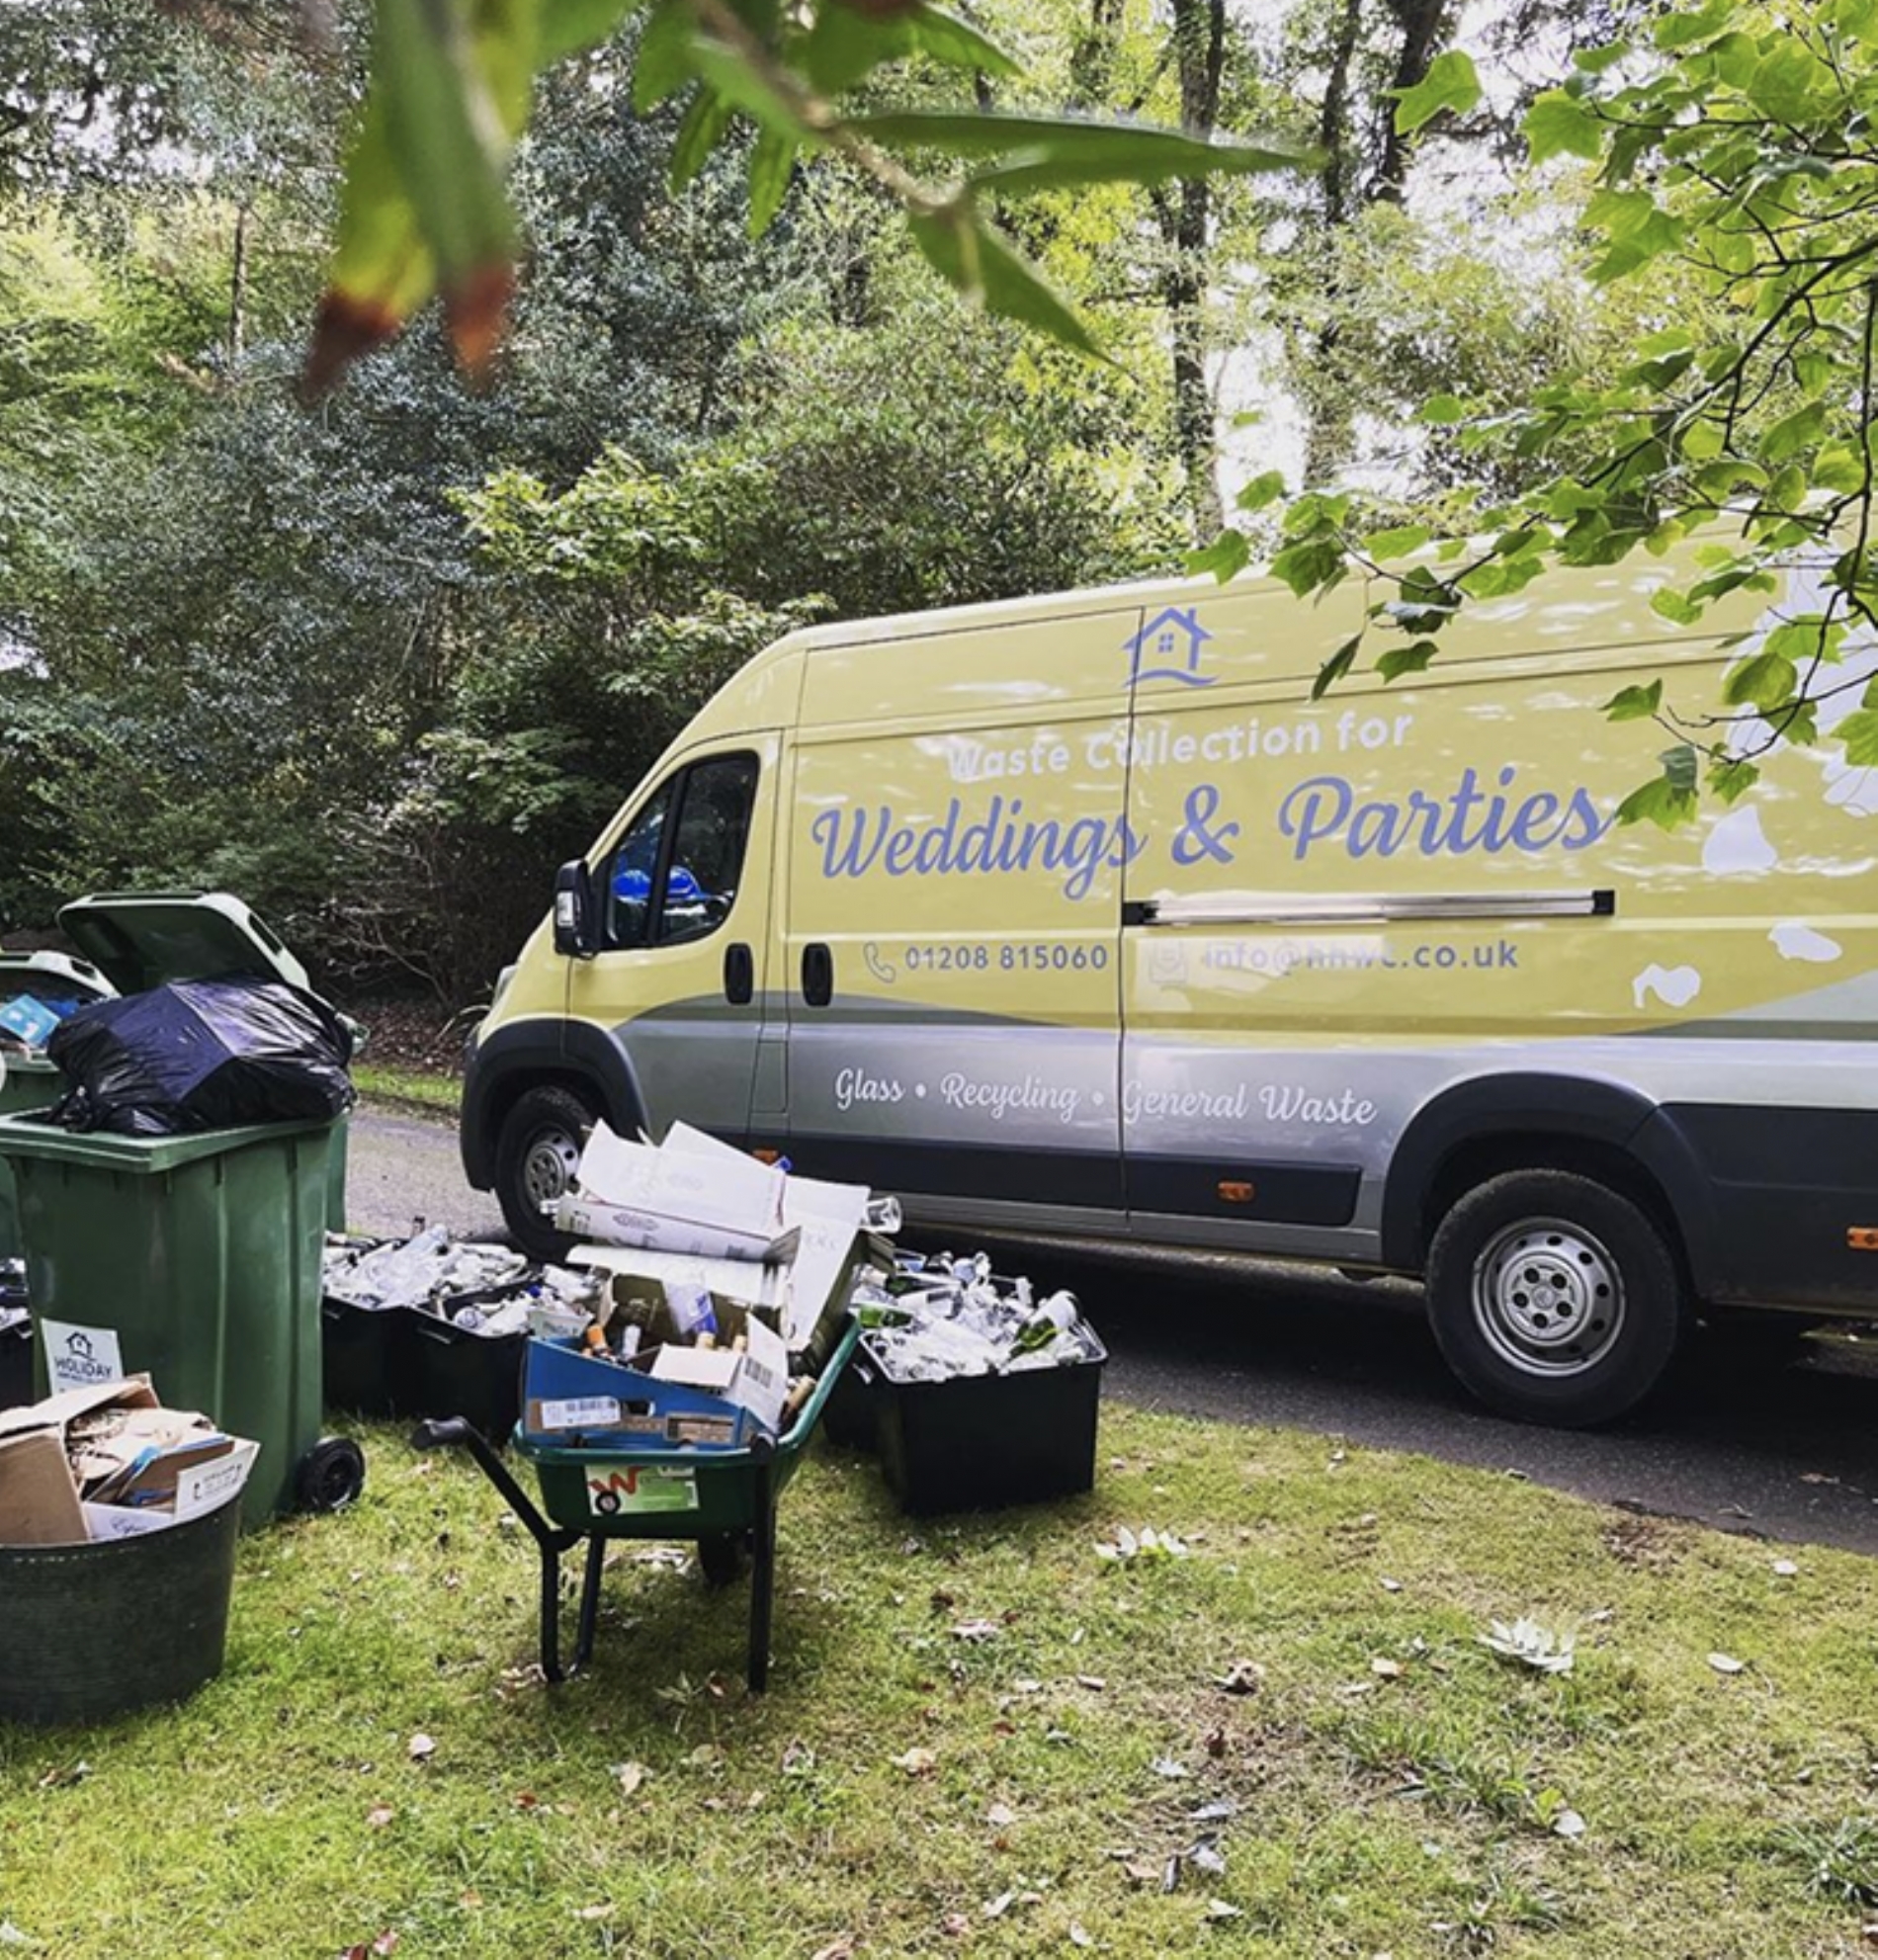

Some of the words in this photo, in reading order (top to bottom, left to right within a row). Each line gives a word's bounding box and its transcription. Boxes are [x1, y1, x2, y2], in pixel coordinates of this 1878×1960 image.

[946, 740, 1070, 780] Waste
[1086, 719, 1321, 770] Collection
[1336, 711, 1413, 751] for
[811, 795, 1148, 900] Weddings
[1171, 784, 1239, 866] &
[1278, 766, 1617, 861] Parties
[905, 945, 988, 970] 01208
[1000, 944, 1108, 970] 815060
[834, 1067, 905, 1111] Glass
[940, 1072, 1080, 1118] Recycling
[1120, 1080, 1248, 1123] General
[1258, 1085, 1378, 1126] Waste
[54, 1356, 113, 1378] HOLIDAY
